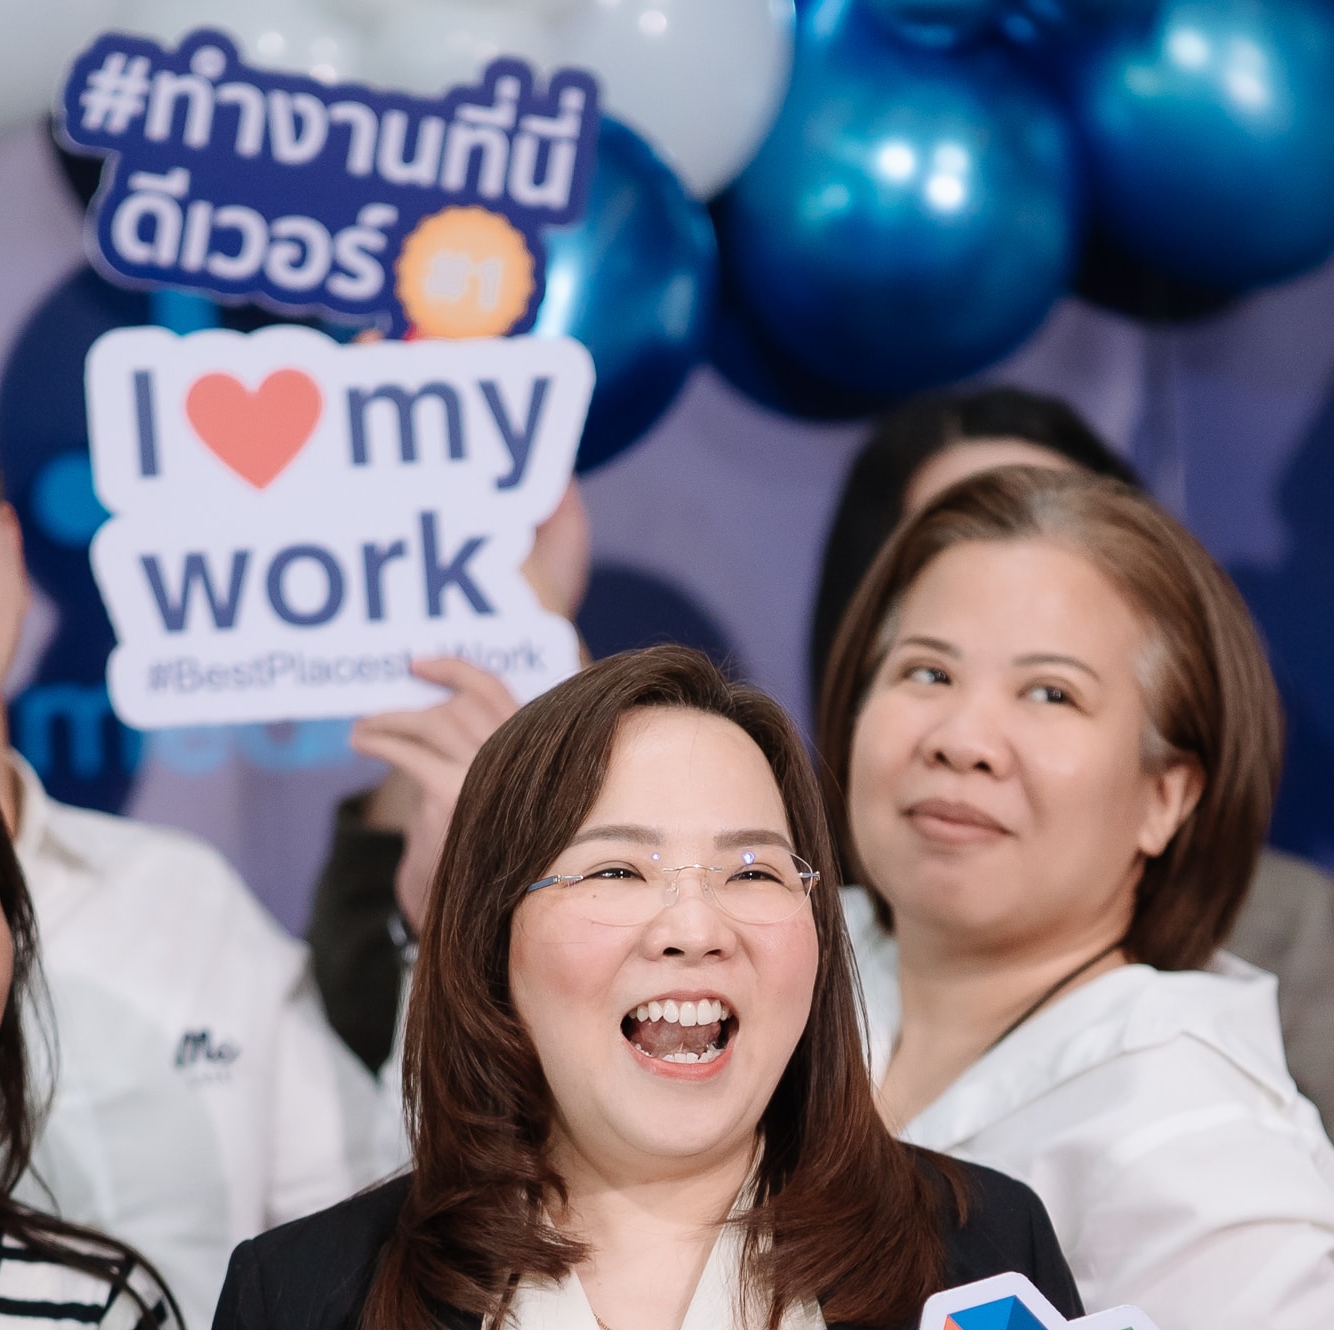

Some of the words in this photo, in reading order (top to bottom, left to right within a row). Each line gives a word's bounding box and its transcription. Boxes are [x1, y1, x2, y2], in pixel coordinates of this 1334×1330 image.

[80, 45, 585, 210] #ทำงานที่นี่
[111, 166, 399, 301] ดีเวอร์
[345, 375, 551, 492] my
[139, 509, 498, 632] work
